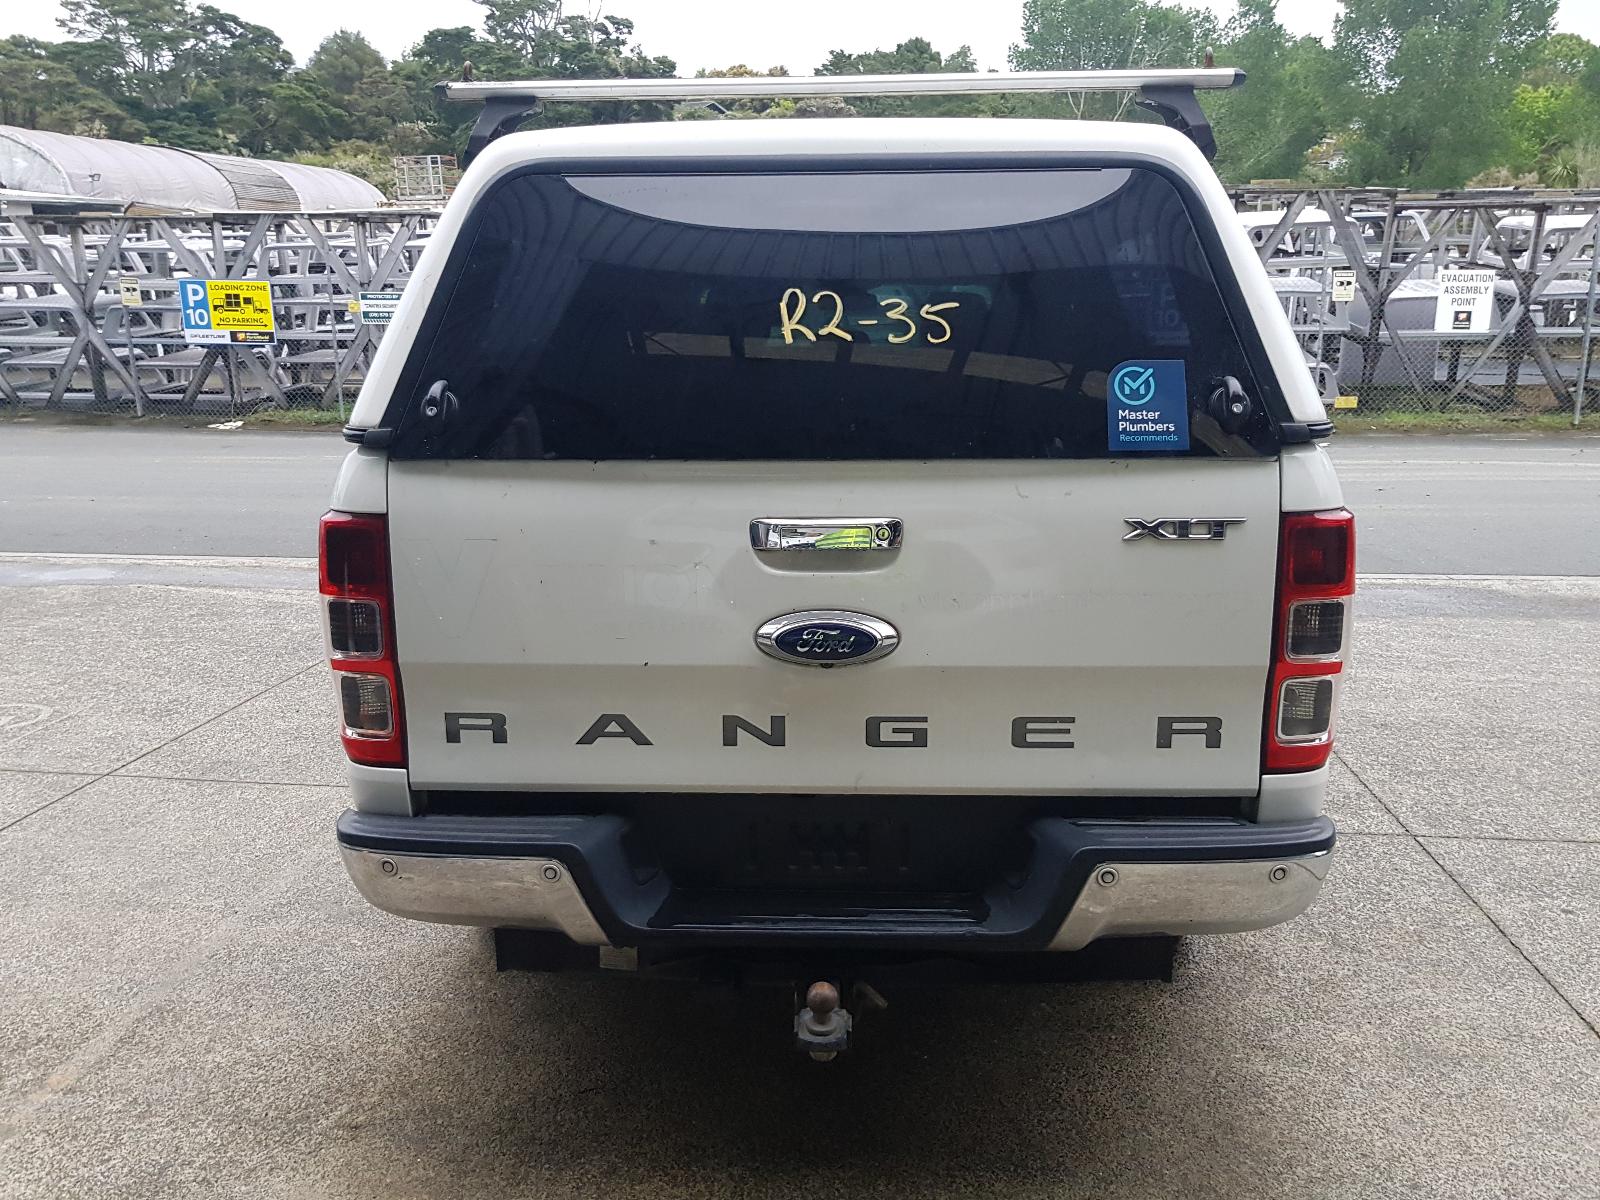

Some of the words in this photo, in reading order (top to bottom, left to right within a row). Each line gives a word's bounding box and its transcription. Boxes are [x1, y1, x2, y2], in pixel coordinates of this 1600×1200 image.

[1441, 273, 1494, 283] EVACUATION
[210, 284, 244, 292] LOADING
[1443, 285, 1490, 295] ASSEMBLY
[186, 283, 205, 307] P
[1451, 297, 1477, 306] POINT
[186, 308, 209, 326] 10
[779, 287, 960, 345] R2-35
[1118, 409, 1160, 420] Master
[1118, 421, 1176, 432] Plumbers
[1119, 434, 1178, 442] Recommends
[1122, 518, 1247, 540] XLT
[796, 628, 856, 653] Ford
[444, 711, 1223, 748] RANGER
